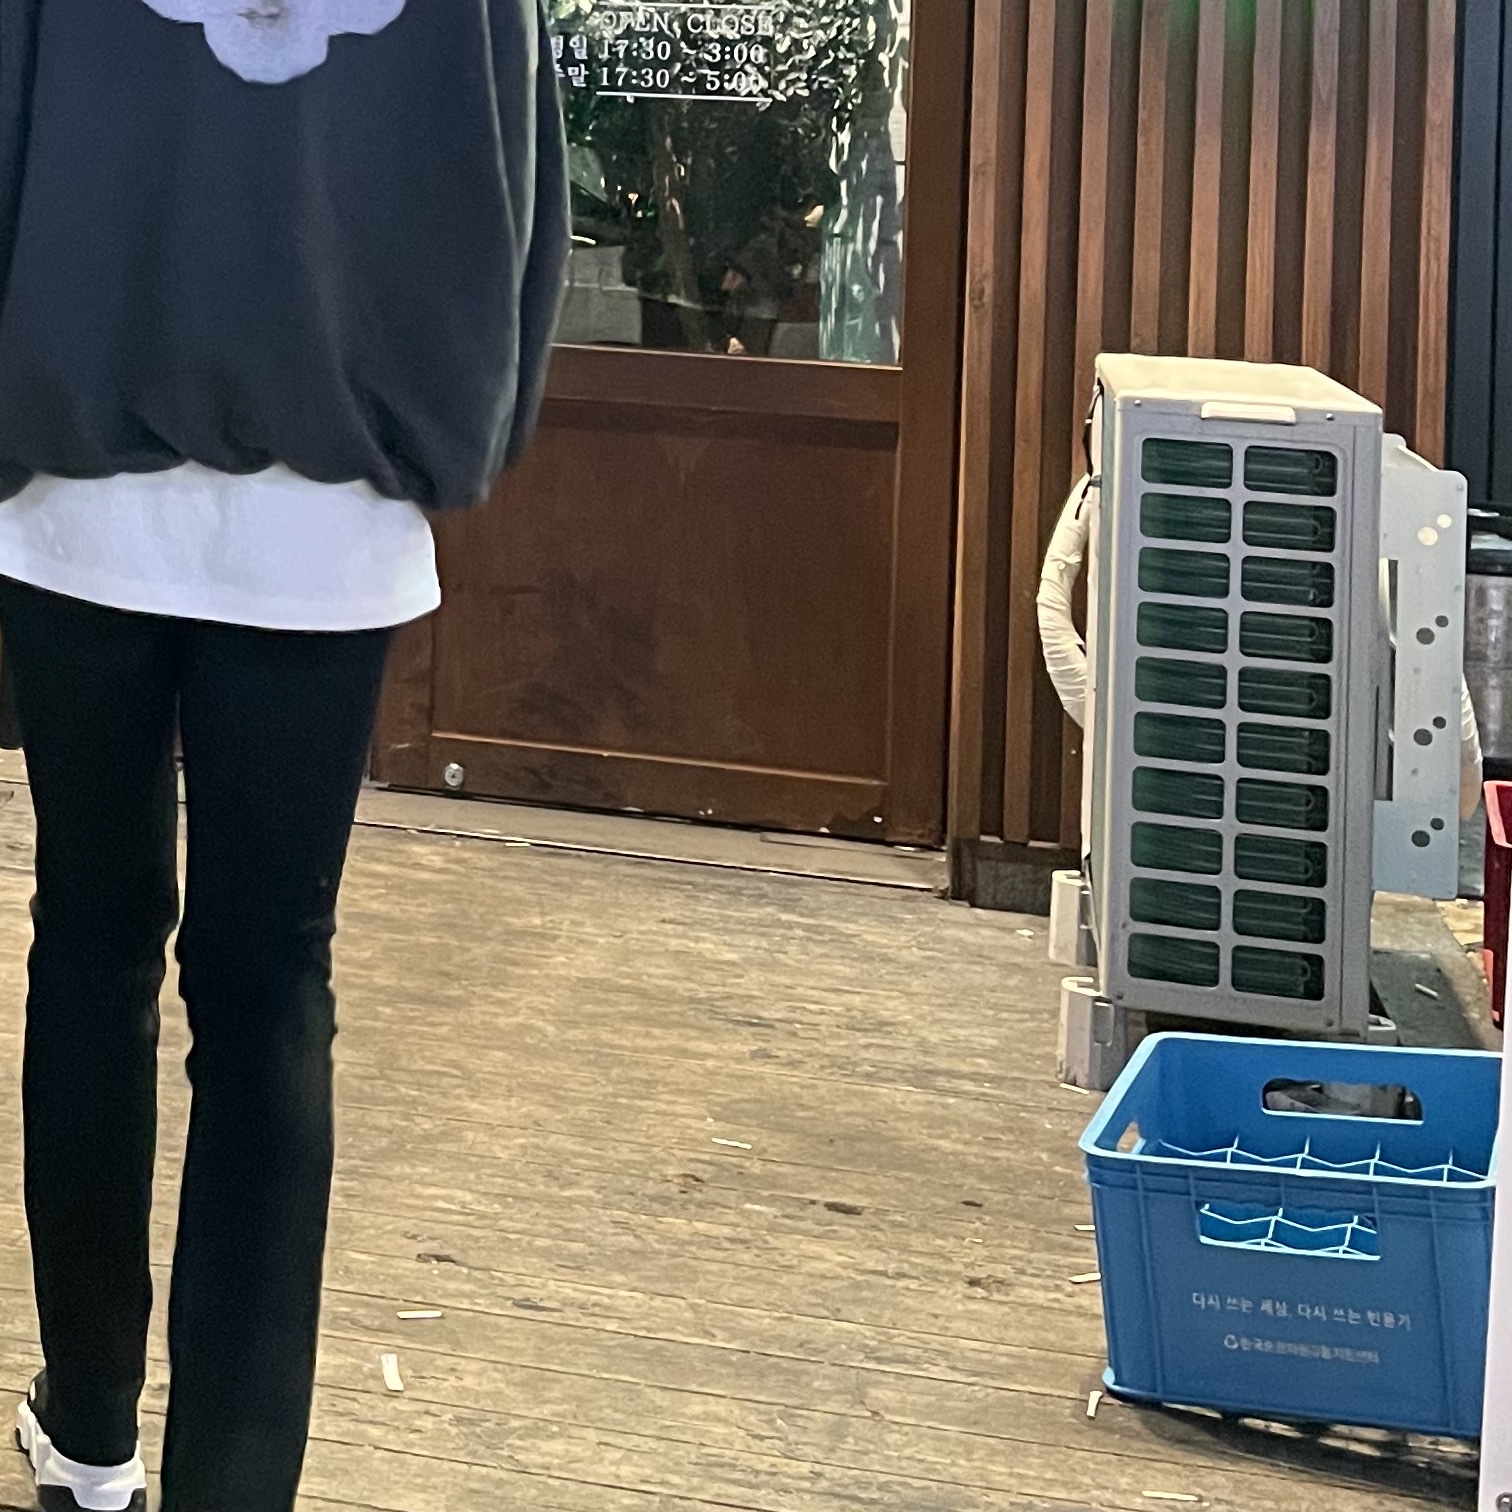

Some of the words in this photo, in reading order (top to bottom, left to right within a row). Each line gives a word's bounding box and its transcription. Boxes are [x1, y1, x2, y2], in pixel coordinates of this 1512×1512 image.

[600, 10, 674, 36] OPEN
[687, 12, 775, 37] CLOSE
[599, 39, 671, 61] 17:30
[704, 42, 765, 65] 3:00
[599, 66, 670, 88] 17:30
[705, 70, 765, 91] 5:00
[1192, 1292, 1221, 1311] 다시
[1226, 1296, 1254, 1313] 쓰는
[1297, 1303, 1327, 1322] 다시
[1332, 1308, 1361, 1325] 쓰는
